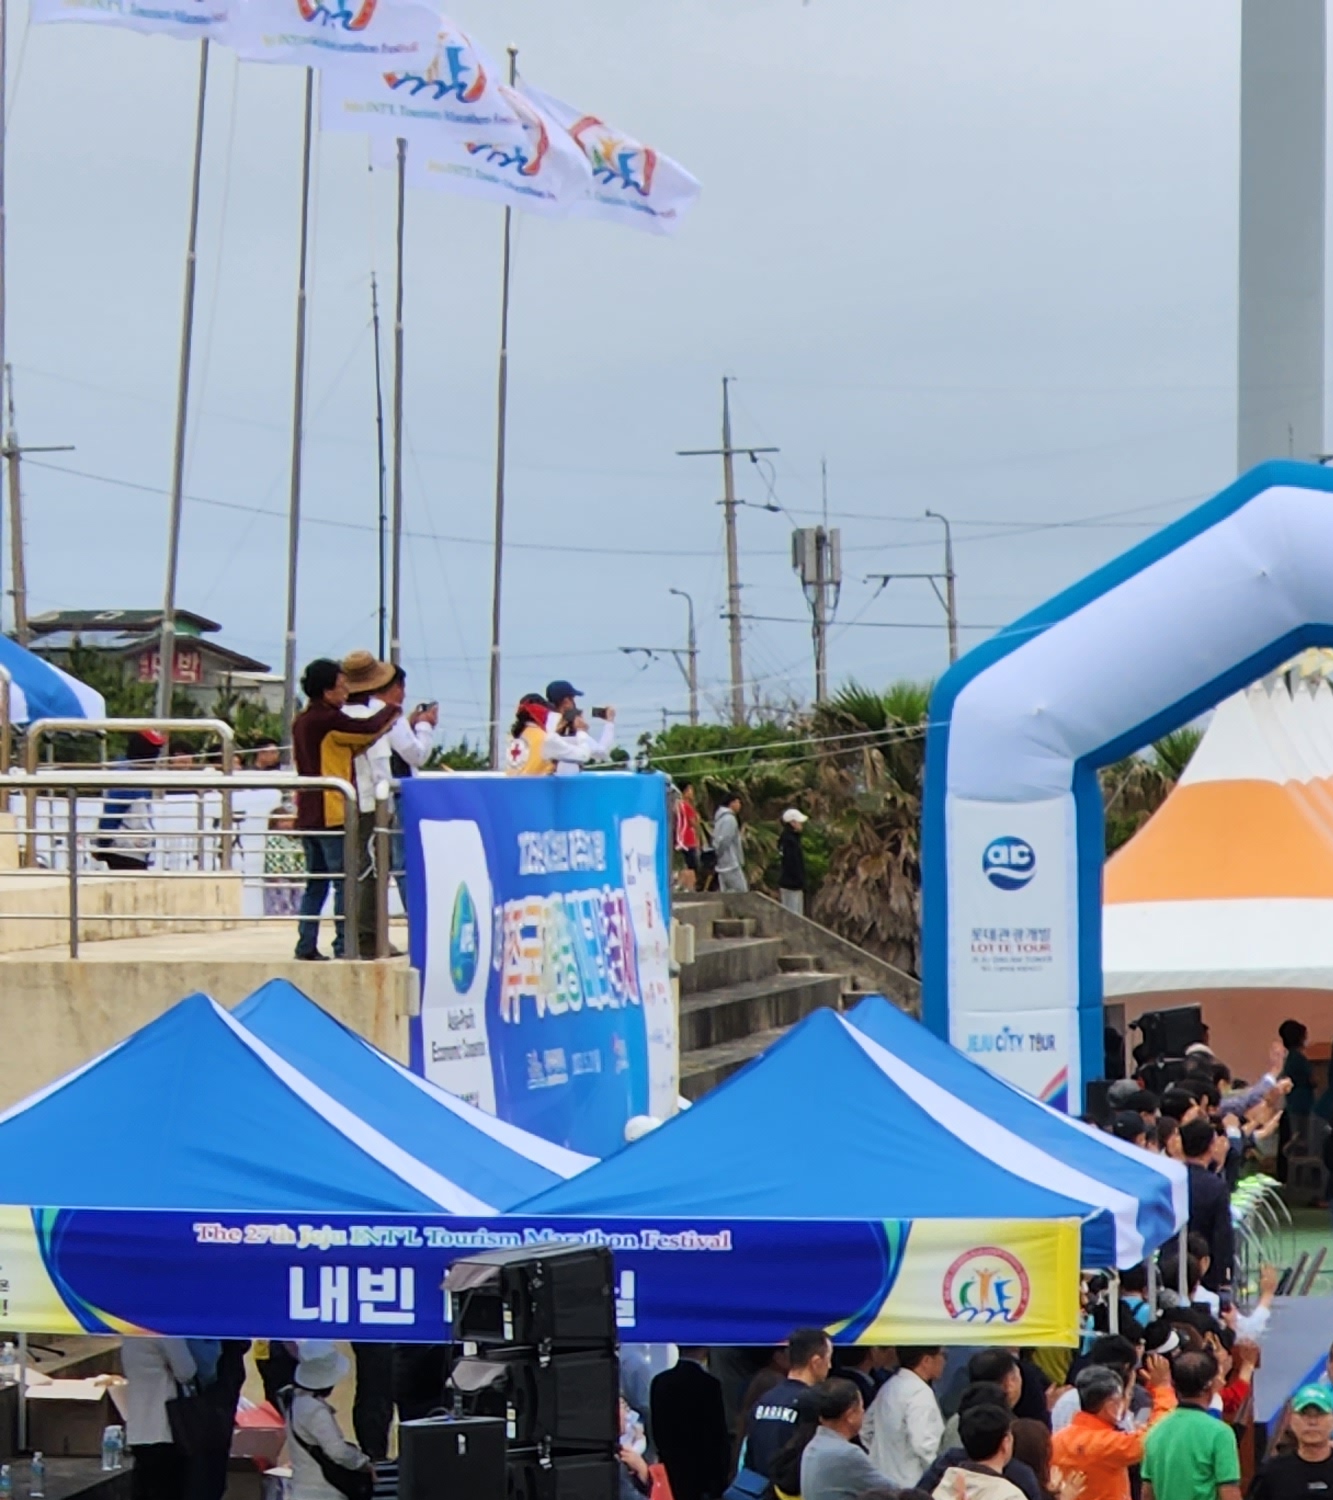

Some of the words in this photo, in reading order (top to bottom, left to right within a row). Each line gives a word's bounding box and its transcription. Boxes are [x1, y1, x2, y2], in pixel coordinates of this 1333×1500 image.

[194, 1224, 241, 1245] The
[244, 1224, 295, 1246] 27th
[297, 1224, 347, 1251] Jeju
[350, 1224, 422, 1248] INT'L
[424, 1226, 520, 1248] Tourism
[525, 1226, 637, 1250] Marathon
[640, 1229, 733, 1251] Festival
[289, 1265, 415, 1325] 내빈
